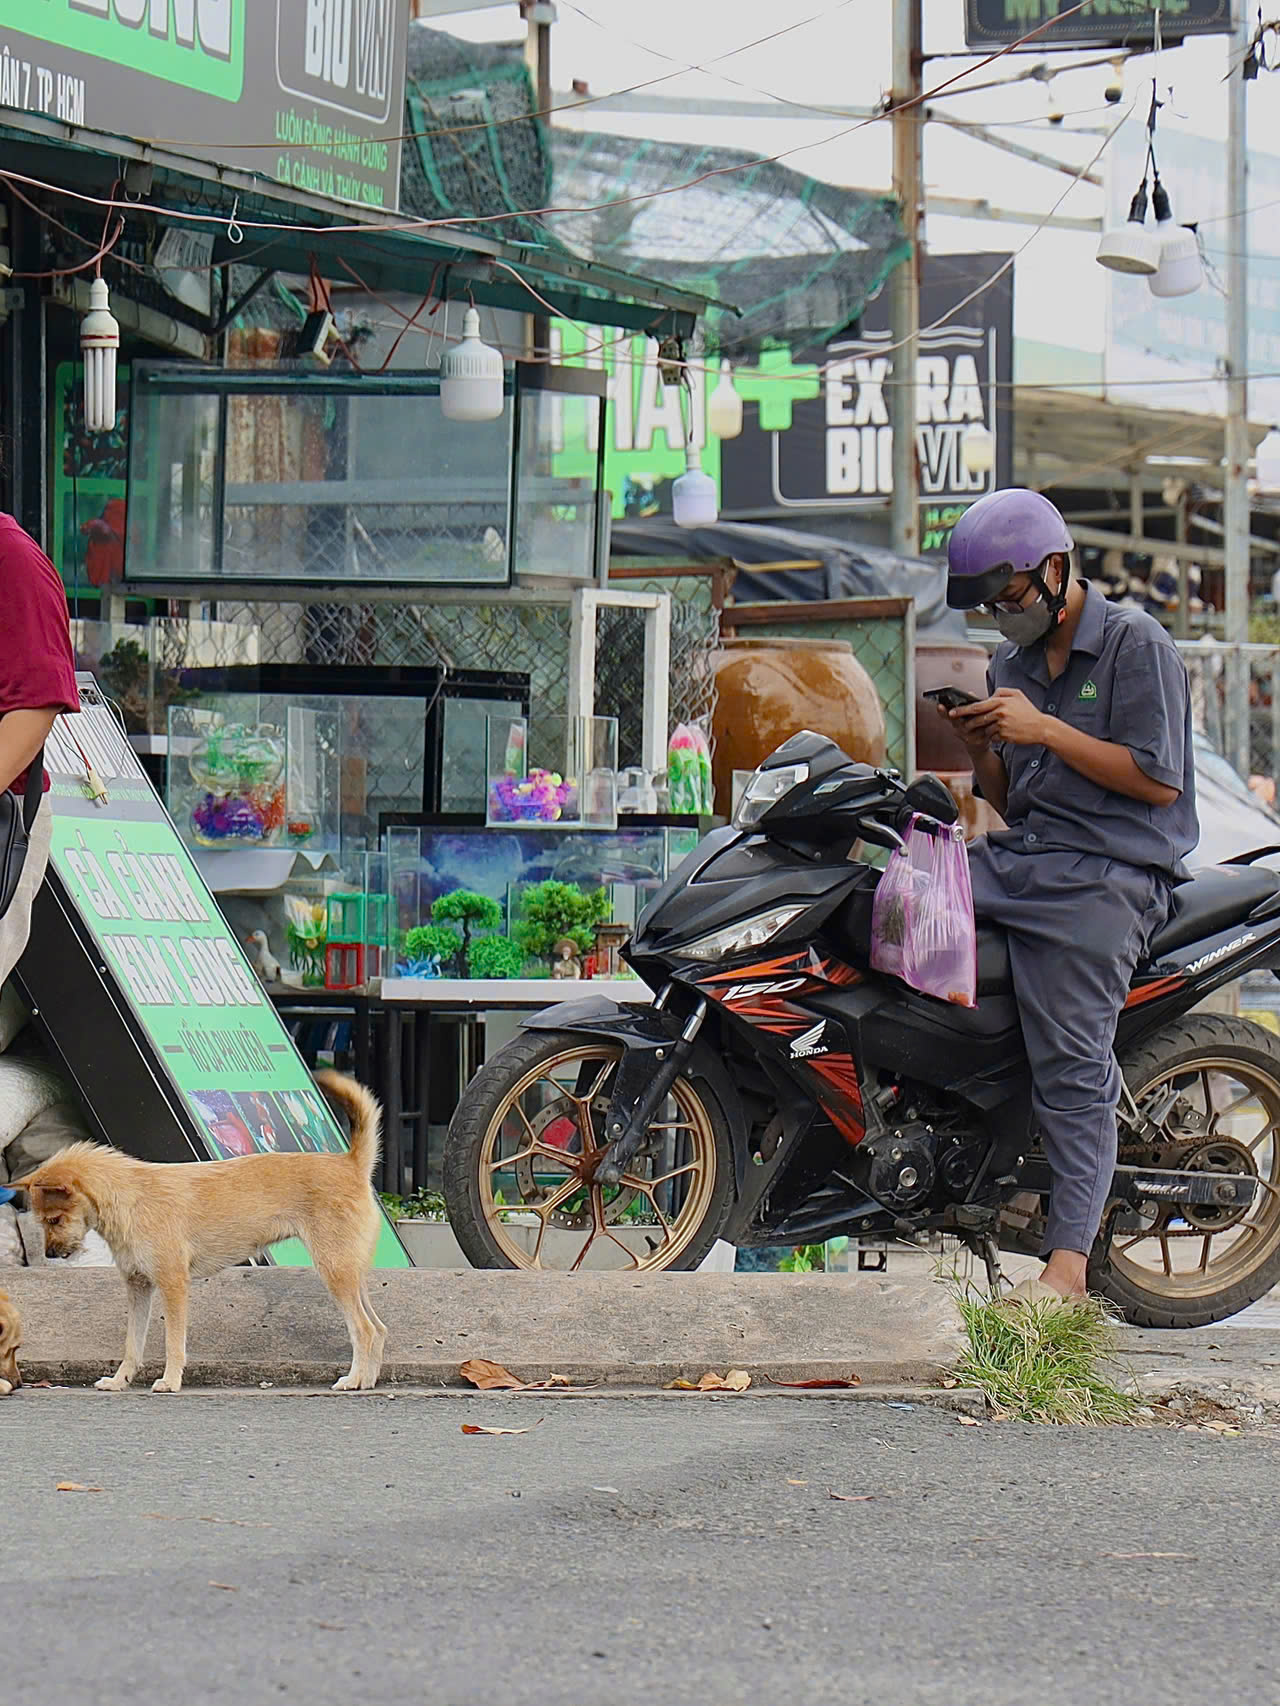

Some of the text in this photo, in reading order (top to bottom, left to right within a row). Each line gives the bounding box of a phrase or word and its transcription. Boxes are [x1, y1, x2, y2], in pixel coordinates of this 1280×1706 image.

[57, 73, 86, 126] HCM
[826, 355, 985, 426] EXRA
[64, 828, 212, 923] CÁ CẢNH
[102, 933, 264, 1007] KIM LONG
[1186, 932, 1257, 973] WINNER
[721, 977, 808, 1001] 150
[790, 1046, 828, 1059] HONDA
